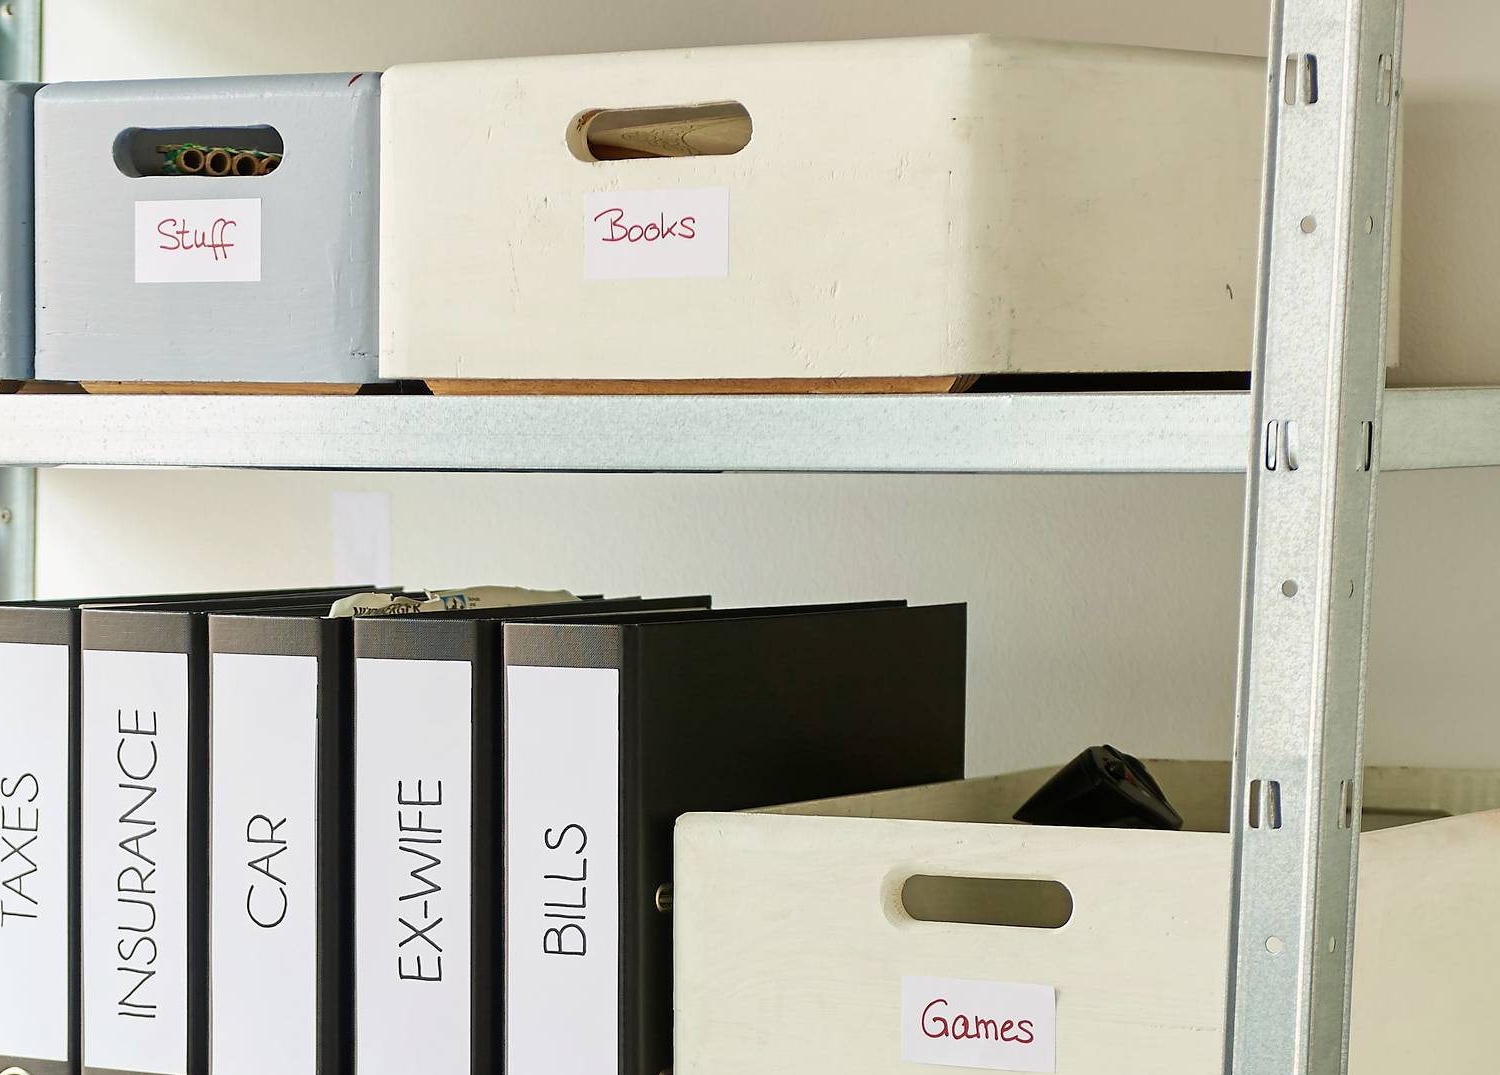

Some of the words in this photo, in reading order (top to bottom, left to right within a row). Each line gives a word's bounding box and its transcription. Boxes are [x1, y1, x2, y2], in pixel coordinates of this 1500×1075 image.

[156, 218, 237, 260] Stuff
[594, 208, 697, 243] Books
[0, 772, 39, 927] TAXES
[117, 708, 158, 1019] INSURANCE
[247, 814, 288, 929] CAR
[399, 779, 443, 983] EX-WIFE
[543, 823, 588, 958] BILLS
[921, 999, 1035, 1044] Games
